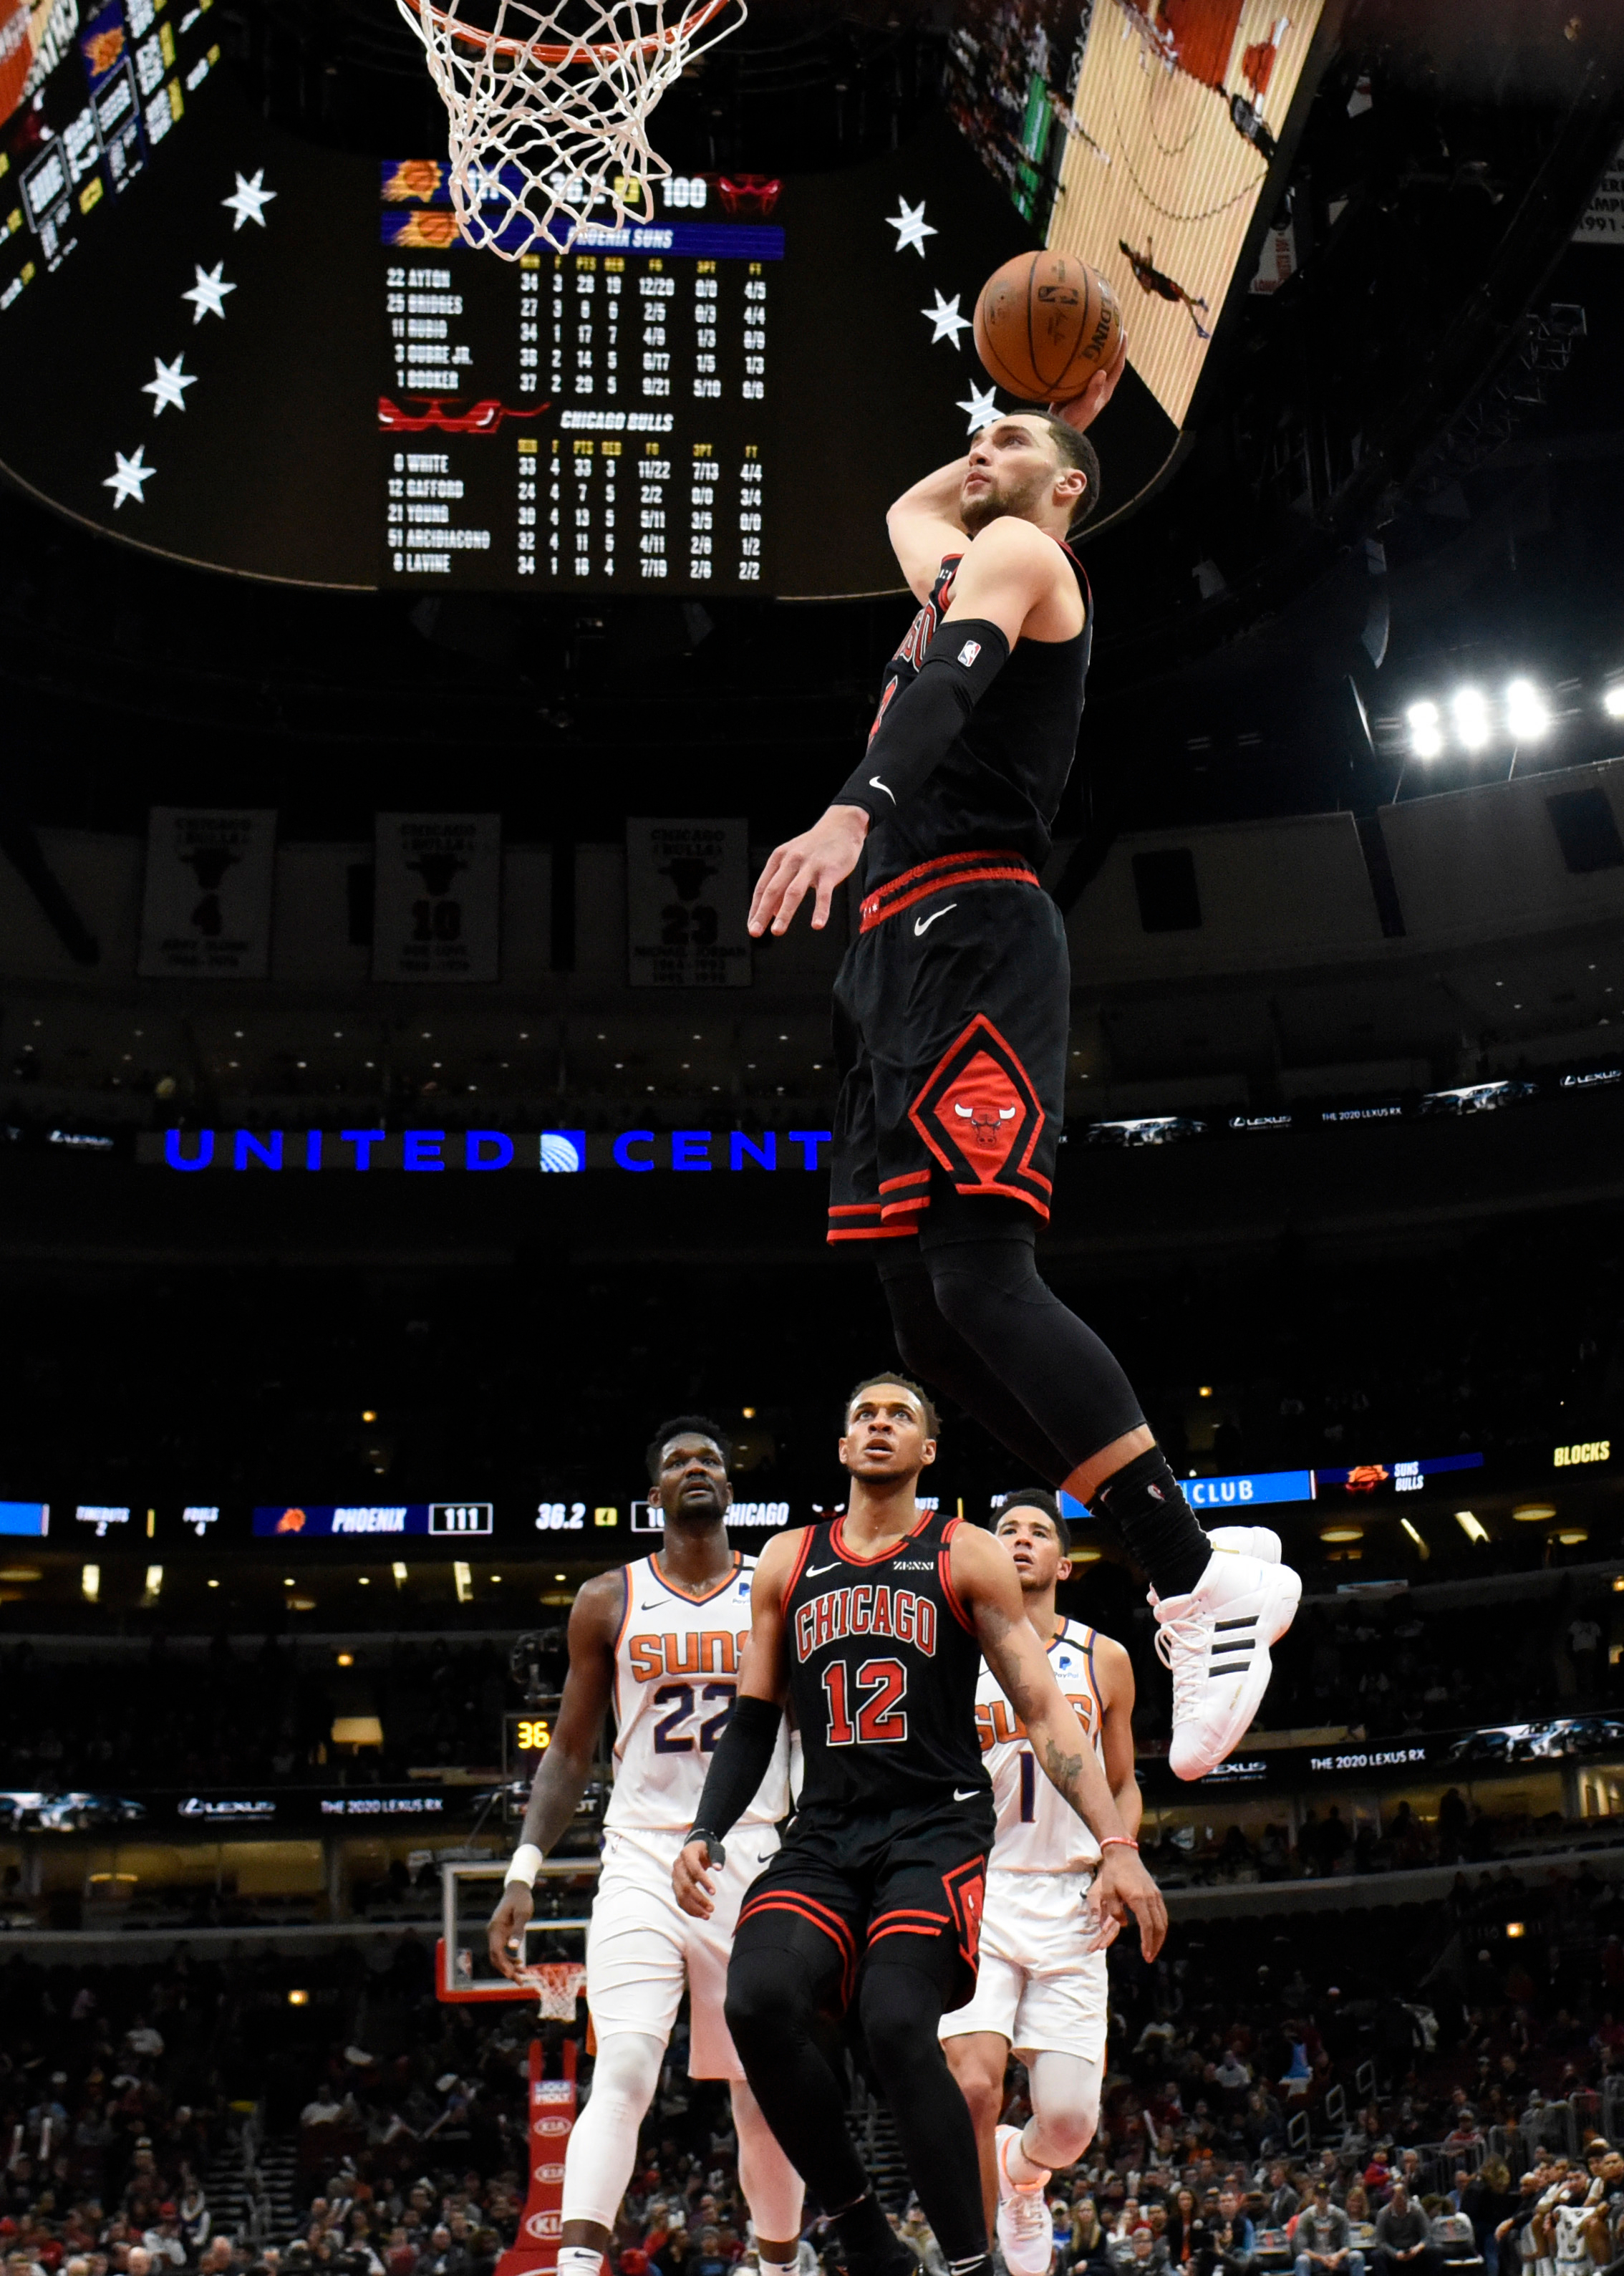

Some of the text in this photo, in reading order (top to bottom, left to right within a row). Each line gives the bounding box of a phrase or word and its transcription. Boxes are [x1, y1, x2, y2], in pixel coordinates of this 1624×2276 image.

[661, 177, 707, 208] 100
[632, 228, 674, 249] SUNS
[387, 269, 405, 286] 22
[639, 277, 675, 296] 12/20
[745, 281, 765, 299] 4/5
[521, 298, 538, 317] 27
[644, 302, 665, 321] 2/5
[744, 307, 765, 324] 4/4
[579, 324, 592, 343] 17
[609, 326, 617, 344] 7
[697, 329, 716, 347] 1/3
[552, 349, 561, 367] 2
[577, 351, 592, 367] 14
[697, 355, 715, 372] 1/5
[745, 356, 764, 374] 1/3
[397, 370, 404, 387] 1
[520, 374, 536, 391] 37
[551, 375, 561, 392] 2
[561, 410, 673, 431] CHICAGO BULLS
[574, 440, 594, 455] PTS
[692, 443, 712, 458] 3PT
[550, 458, 560, 476] 4
[638, 460, 670, 479] 11/22
[692, 462, 719, 481] 7/13
[740, 464, 762, 481] 4/4
[388, 479, 403, 497] 12
[518, 482, 536, 500] 24
[550, 483, 559, 500] 4
[579, 483, 587, 501] 7
[606, 484, 614, 502] 5
[641, 486, 662, 503] 2/2
[692, 487, 713, 505] 0/0
[740, 488, 761, 506] 3/4
[387, 503, 403, 521] 21
[550, 508, 559, 525] 4
[576, 508, 589, 526] 13
[606, 509, 614, 527] 5
[641, 510, 665, 528] 5/11
[692, 511, 712, 529] 3/5
[740, 513, 761, 531] 0/0
[388, 529, 403, 547] 51
[518, 531, 535, 550] 32
[550, 533, 559, 550] 4
[576, 534, 588, 551] 11
[606, 534, 614, 551] 5
[640, 534, 664, 553] 4/11
[743, 537, 760, 556] 1/2
[518, 556, 535, 574] 34
[551, 557, 557, 574] 1
[604, 559, 614, 576] 4
[739, 561, 760, 579] 2/2
[190, 893, 223, 936] 4
[412, 900, 462, 941] 10
[661, 903, 719, 946] 23
[1577, 1071, 1620, 1083] LEXUS
[1247, 1117, 1290, 1125] LEXUS
[1339, 1111, 1360, 1120] 2020
[1362, 1109, 1388, 1117] LEXUS
[165, 1129, 832, 1171] UNITED CENT
[1554, 1441, 1610, 1467] BLOCKS
[1393, 1461, 1421, 1478] SUNS
[1193, 1479, 1255, 1504] CLUB
[1395, 1474, 1424, 1491] BULLS
[332, 1507, 407, 1533] PHOENIX
[445, 1508, 478, 1530] 111
[535, 1503, 586, 1530] 36.2
[893, 1561, 934, 1571] ZENNI
[795, 1585, 937, 1664] CHICAGO
[822, 1657, 907, 1746] 12
[654, 1683, 738, 1754] 22
[975, 1694, 1092, 1752] SUS
[518, 1721, 551, 1749] 36
[1211, 1761, 1267, 1774] EXUS
[1311, 1749, 1424, 1769] THE 2020 LEXUS RX
[1019, 1750, 1035, 1823] 1
[204, 1802, 274, 1813] LEXUS
